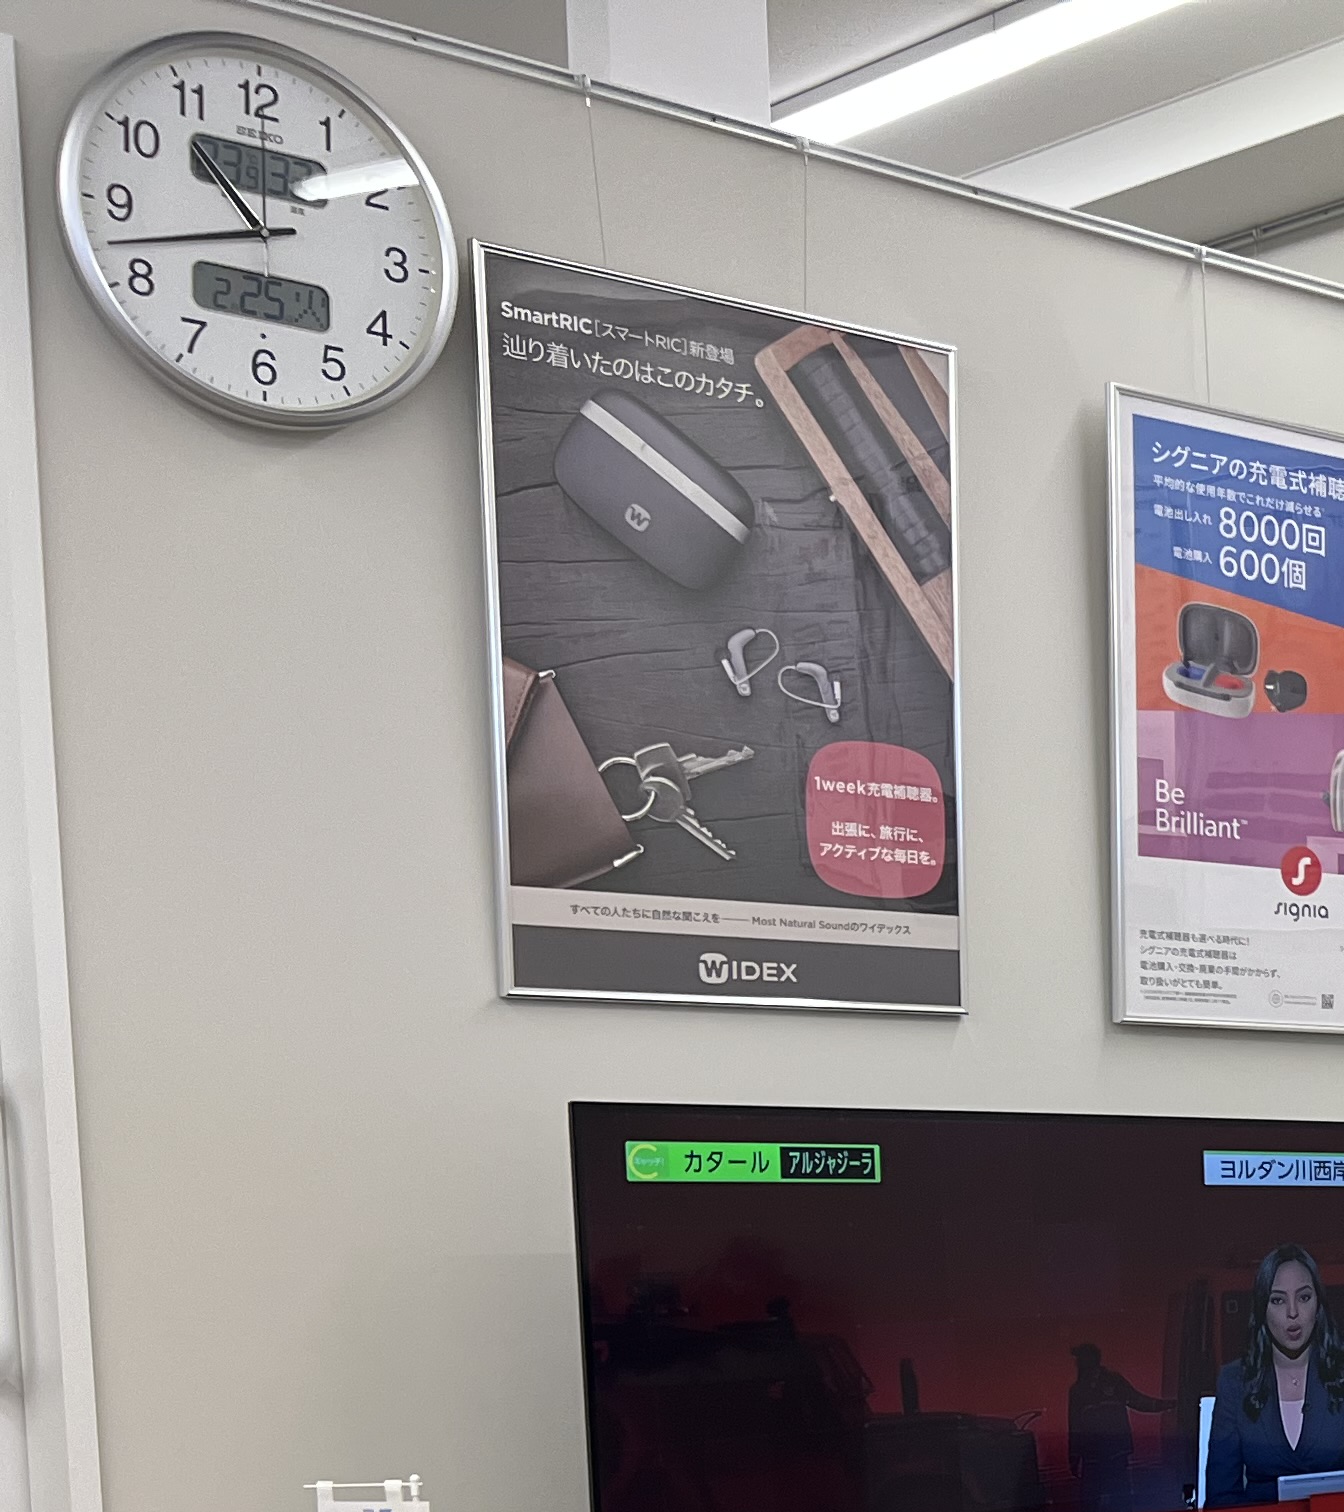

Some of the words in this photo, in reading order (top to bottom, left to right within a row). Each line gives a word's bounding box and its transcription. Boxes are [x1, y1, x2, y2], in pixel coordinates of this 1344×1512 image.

[173, 79, 205, 121] 11
[237, 79, 280, 123] 12
[116, 116, 160, 159] 10
[236, 125, 284, 145] SEIKO
[319, 117, 332, 152] 1
[106, 183, 133, 222] 9
[128, 258, 155, 297] 8
[383, 247, 409, 283] 3
[181, 316, 208, 354] 7
[365, 310, 393, 346] 4
[251, 349, 278, 386] 6
[321, 345, 346, 381] 5
[502, 332, 764, 408] 辿り着いたのはこのカタチ。
[1154, 503, 1213, 526] 電池出し入れ
[1218, 507, 1326, 557] 8000回
[1218, 545, 1307, 591] 600個
[814, 775, 938, 804] 1week充電補聴器。
[1155, 778, 1186, 805] Be
[831, 821, 924, 844] 出張に、旅行に、
[819, 842, 936, 867] アクティブな毎日を。
[752, 915, 776, 927] Most
[779, 917, 816, 930] Natural
[1274, 901, 1330, 922] signia
[699, 952, 798, 984] WIDEX
[684, 1150, 770, 1174] カタール
[789, 1151, 873, 1176] アルジャジーラ
